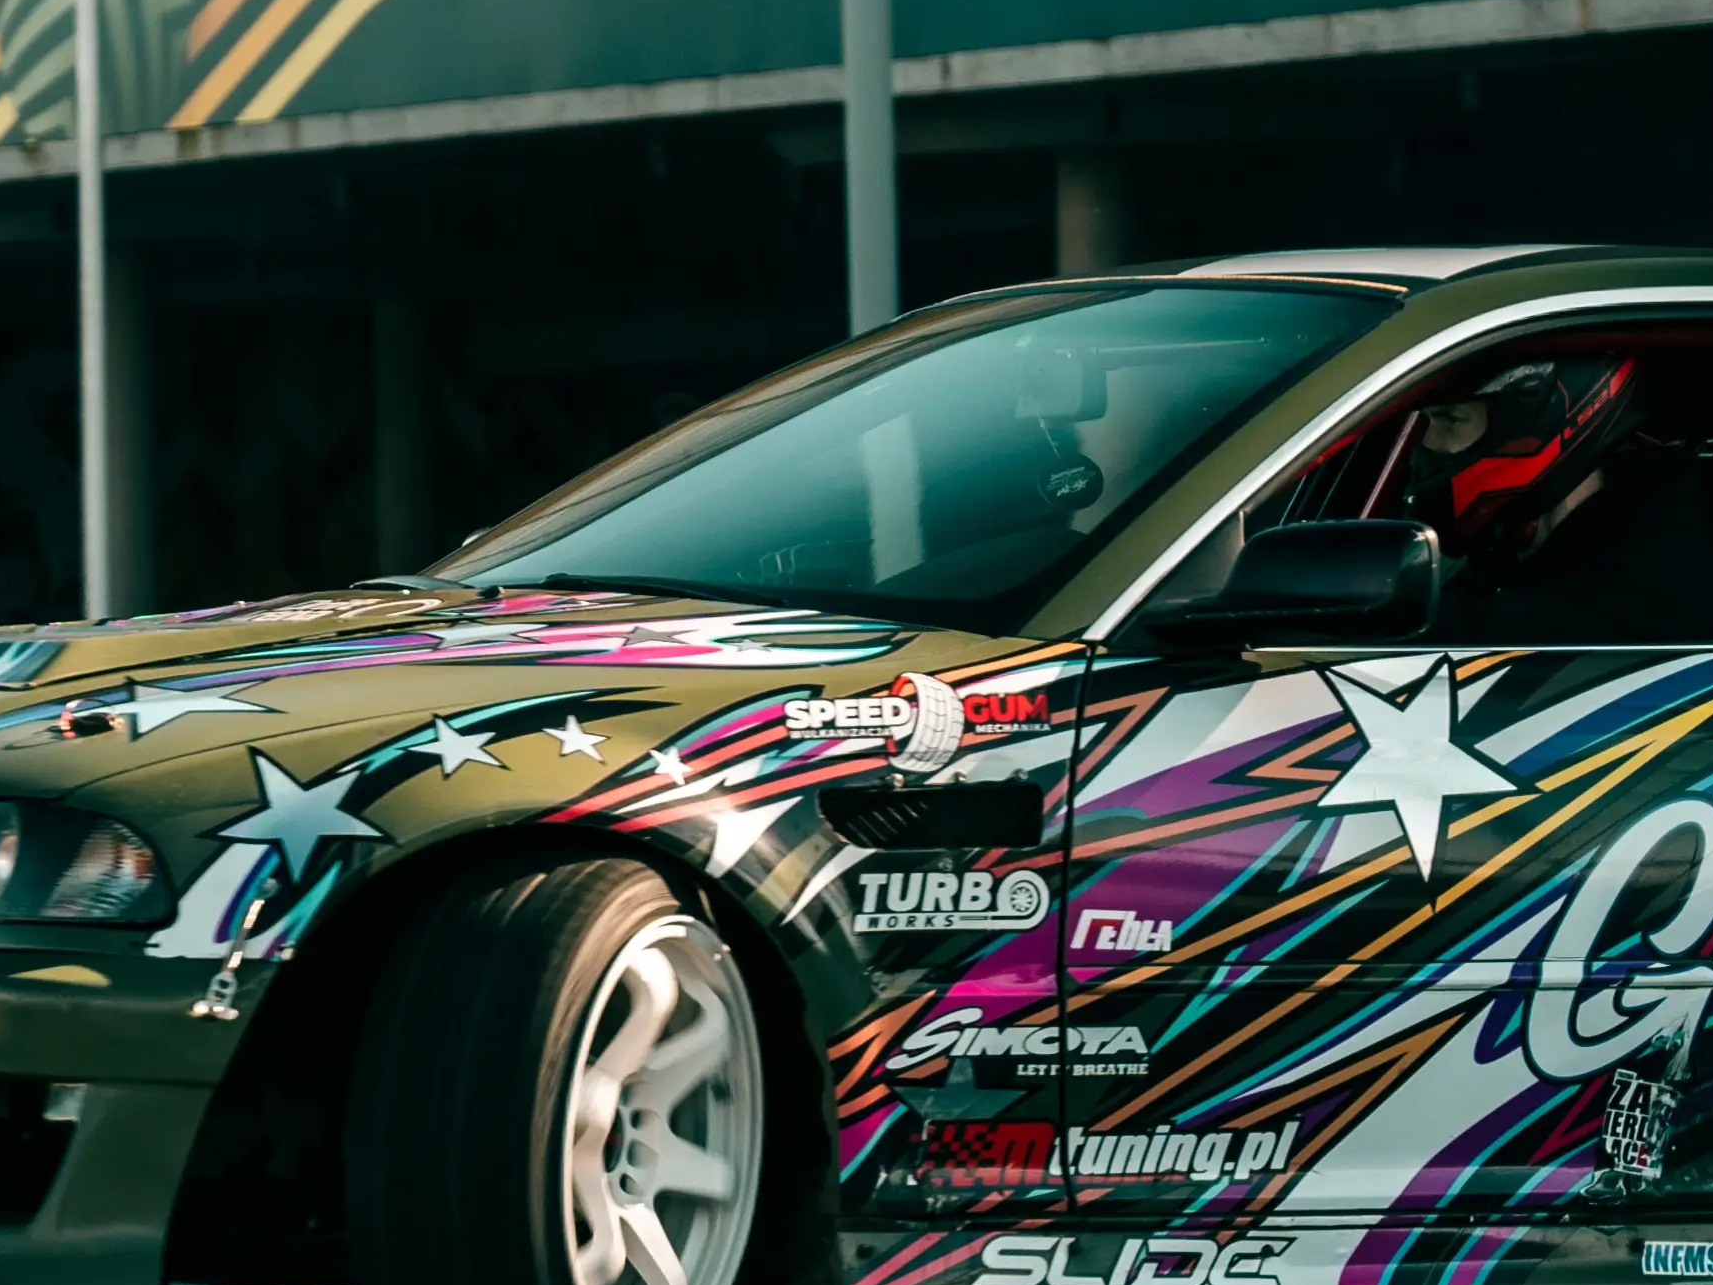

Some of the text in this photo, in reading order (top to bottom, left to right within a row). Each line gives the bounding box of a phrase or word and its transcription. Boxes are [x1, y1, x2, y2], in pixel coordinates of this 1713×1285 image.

[784, 692, 1050, 729] SPEED GUM
[975, 722, 1052, 734] MECHANIKA
[859, 870, 1050, 914] TURBO
[868, 915, 955, 929] WORKS
[885, 1007, 1148, 1070] SIMOTA
[1017, 1064, 1043, 1076] LET
[1072, 1063, 1148, 1076] BREATHE
